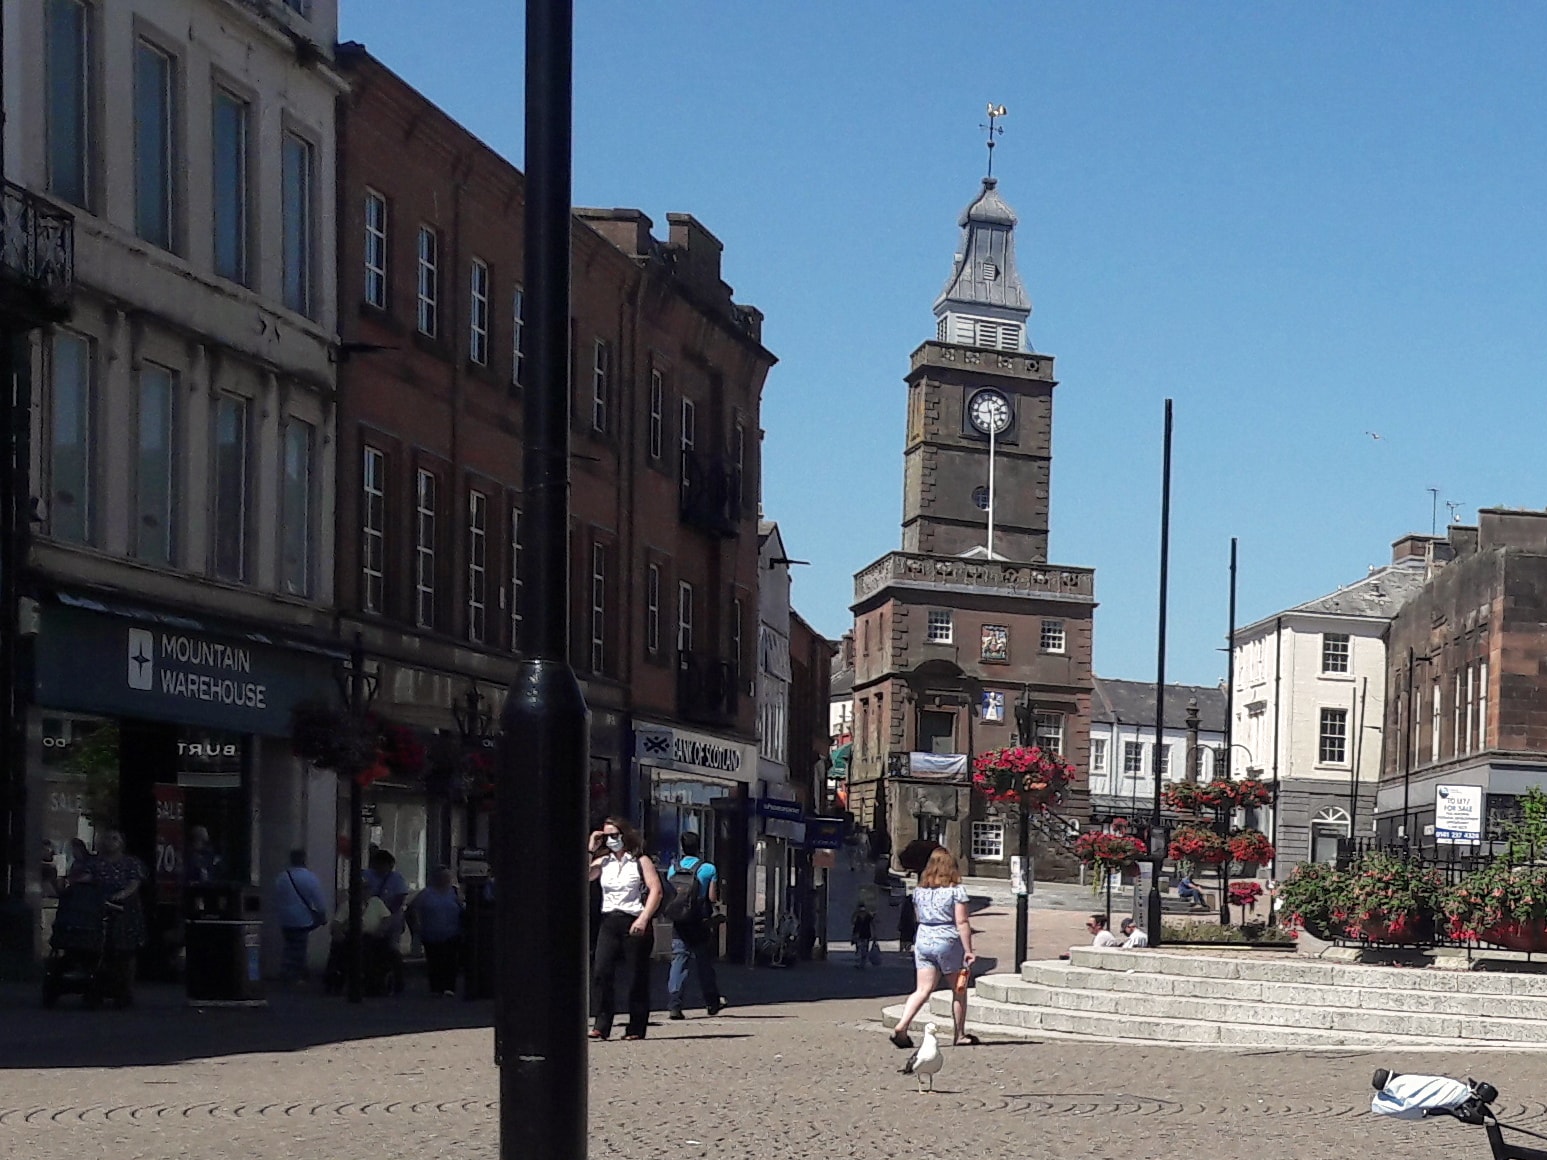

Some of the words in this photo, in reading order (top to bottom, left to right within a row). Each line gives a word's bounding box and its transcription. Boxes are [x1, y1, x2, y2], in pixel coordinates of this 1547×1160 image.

[161, 633, 251, 673] MOUNTAIN
[161, 668, 267, 709] WAREHOUSE
[674, 737, 692, 764] BANK
[706, 744, 741, 772] SCOTLAND
